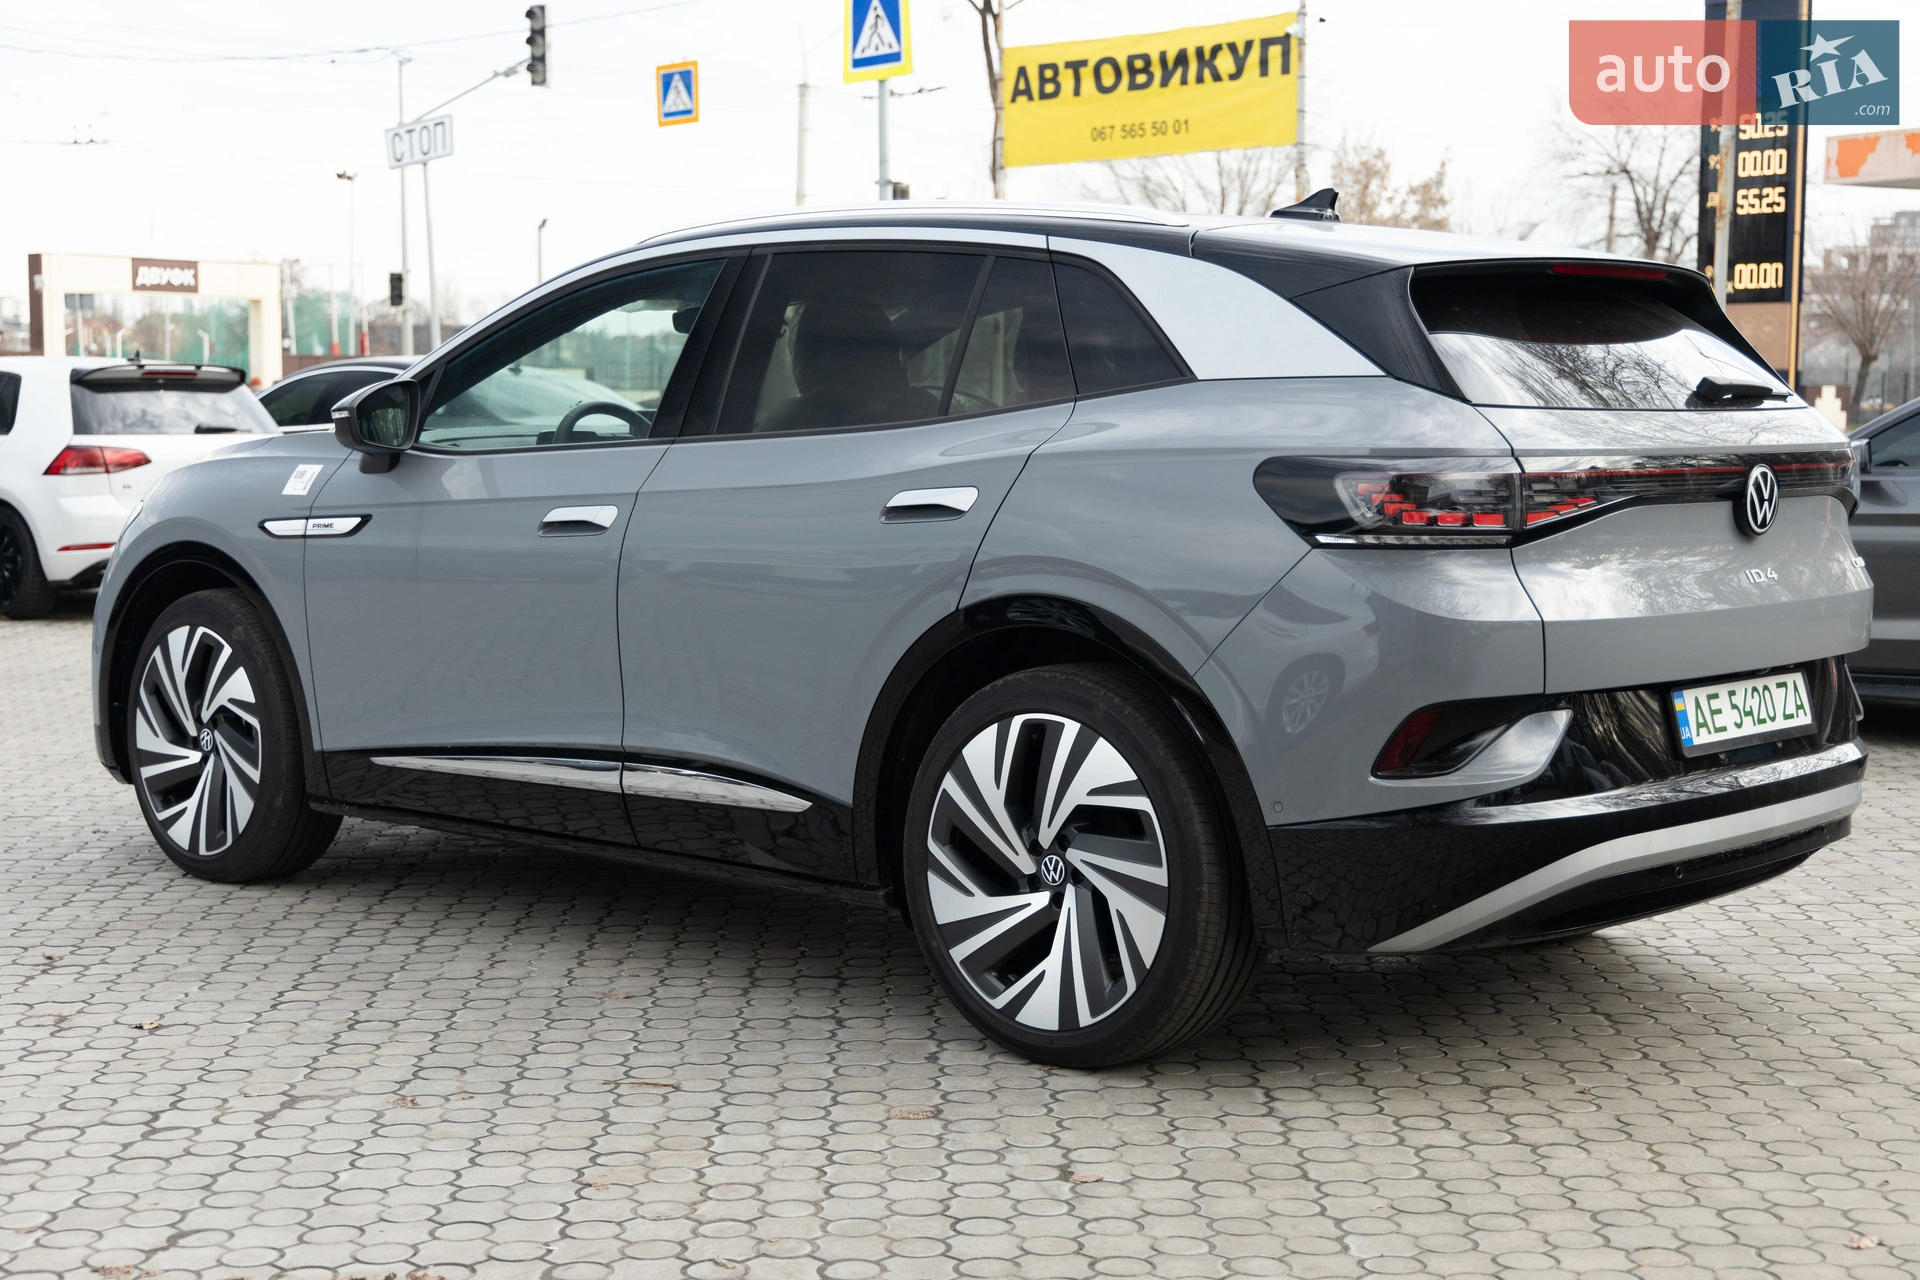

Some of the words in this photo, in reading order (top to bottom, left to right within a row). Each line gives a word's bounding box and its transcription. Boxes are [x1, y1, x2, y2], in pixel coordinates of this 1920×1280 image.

[1010, 32, 1292, 103] АВТОВИКУП
[391, 121, 446, 162] СТОП
[1091, 125, 1115, 142] 067
[1121, 123, 1147, 139] 565
[1151, 121, 1168, 137] 50
[1173, 118, 1190, 135] 01
[1736, 186, 1786, 215] 55.25
[1693, 692, 1728, 737] AE
[1727, 684, 1777, 730] 5420
[1775, 679, 1807, 721] ZA
